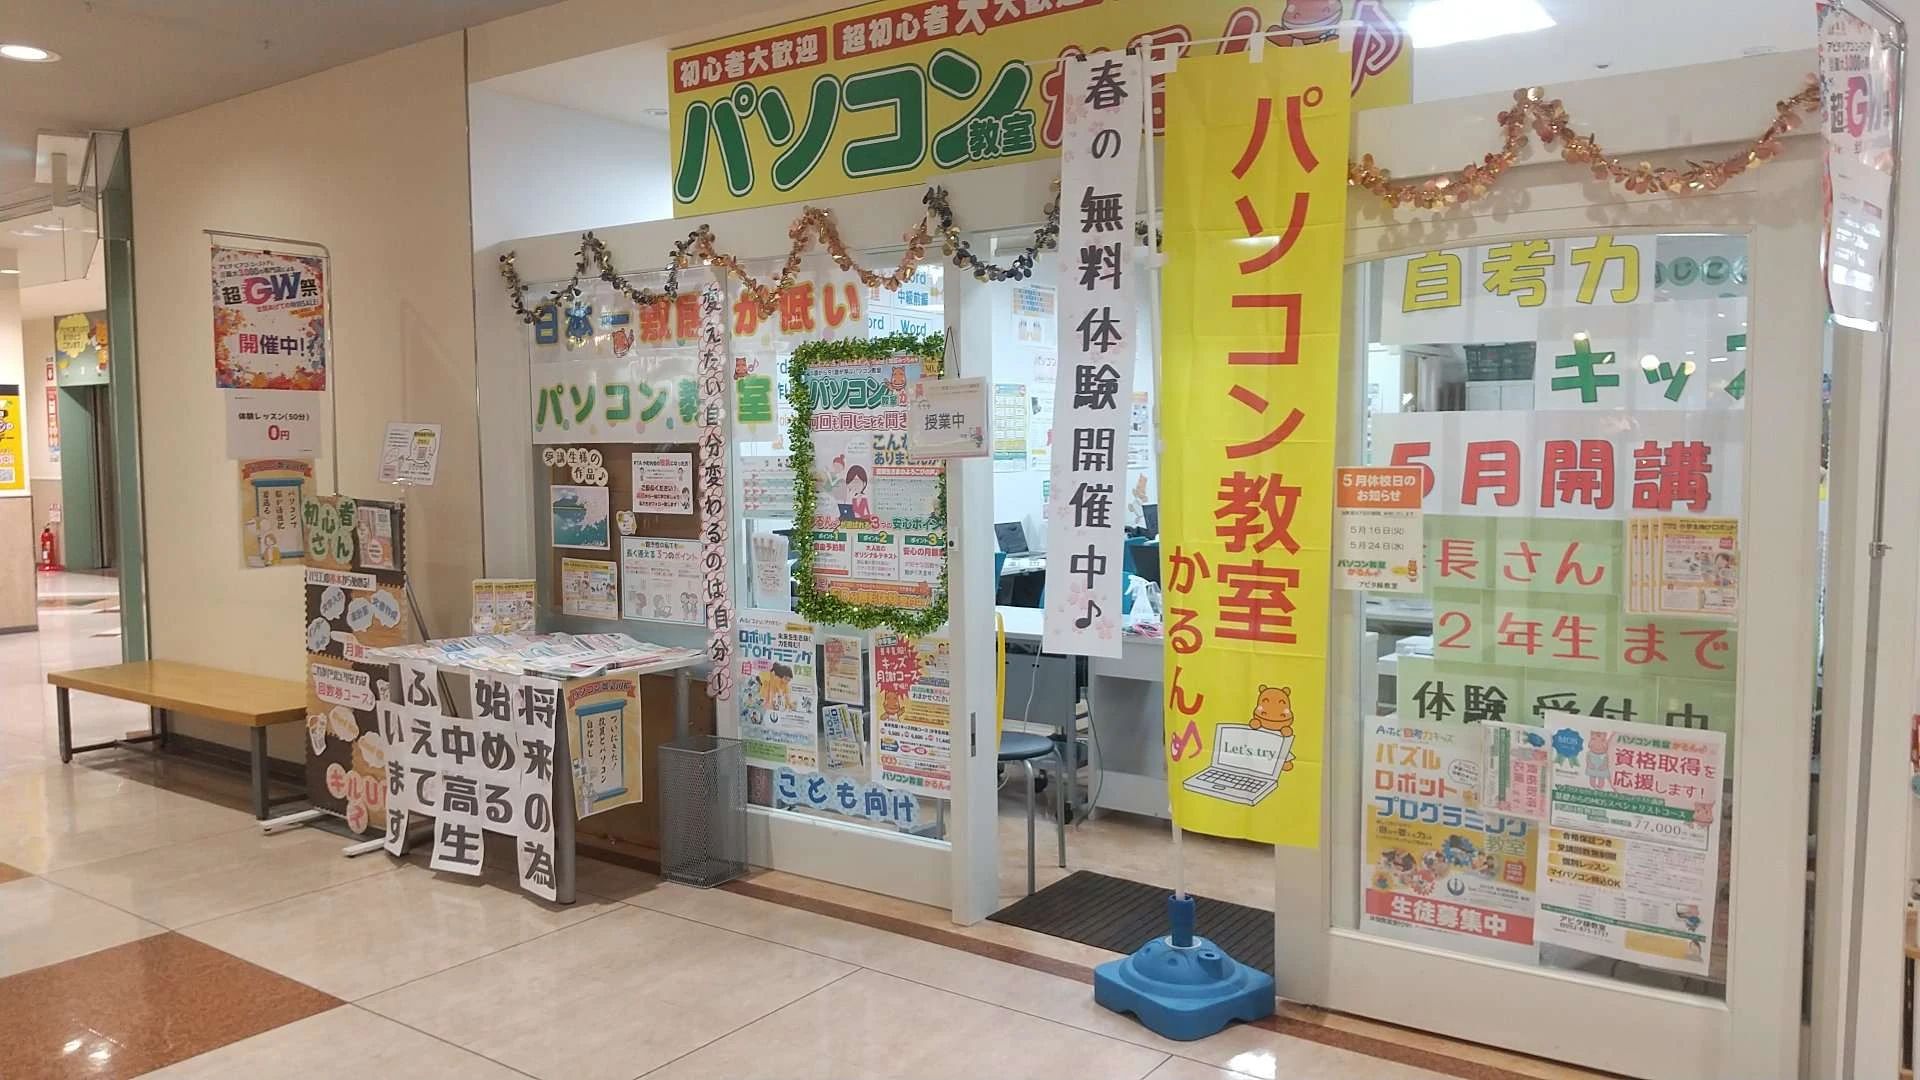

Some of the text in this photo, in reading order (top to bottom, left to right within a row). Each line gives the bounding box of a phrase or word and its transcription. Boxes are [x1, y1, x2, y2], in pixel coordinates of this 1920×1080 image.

[679, 34, 820, 89] 初心者大歓迎
[674, 48, 1032, 205] パソコン
[967, 111, 1036, 162] 教室
[222, 272, 319, 306] 超GW祭
[1402, 234, 1640, 313] 自考力
[239, 334, 305, 357] 開催中!
[900, 320, 927, 337] Word
[1213, 86, 1324, 645] パソコン教室
[810, 376, 891, 410] パソコン
[267, 424, 291, 441] 0円
[924, 412, 965, 431] 授業中
[573, 467, 596, 482] 作品
[1342, 473, 1416, 488] 5月休校日の
[1390, 439, 1713, 512] 5月開講
[1356, 489, 1402, 502] お知らせ
[303, 500, 355, 534] 初心者
[311, 532, 350, 559] さん
[1422, 540, 1606, 586] 長さん
[1167, 545, 1212, 716] かるん
[1438, 611, 1729, 671] 2年生まで
[881, 655, 909, 670] キッズ
[407, 667, 439, 807] ふえて
[475, 678, 517, 824] 始める
[1254, 745, 1277, 761] try
[1375, 742, 1441, 770] パズル
[1614, 748, 1717, 779] 資格取得を
[384, 709, 406, 844] います
[518, 683, 557, 890] 将来の為
[1375, 769, 1457, 799] ロボット
[1613, 770, 1705, 799] 応援します!
[438, 725, 481, 866] 中高生
[778, 772, 914, 823] こども向け
[1374, 795, 1528, 838] プログラミング
[1390, 895, 1508, 937] 生徒募集中
